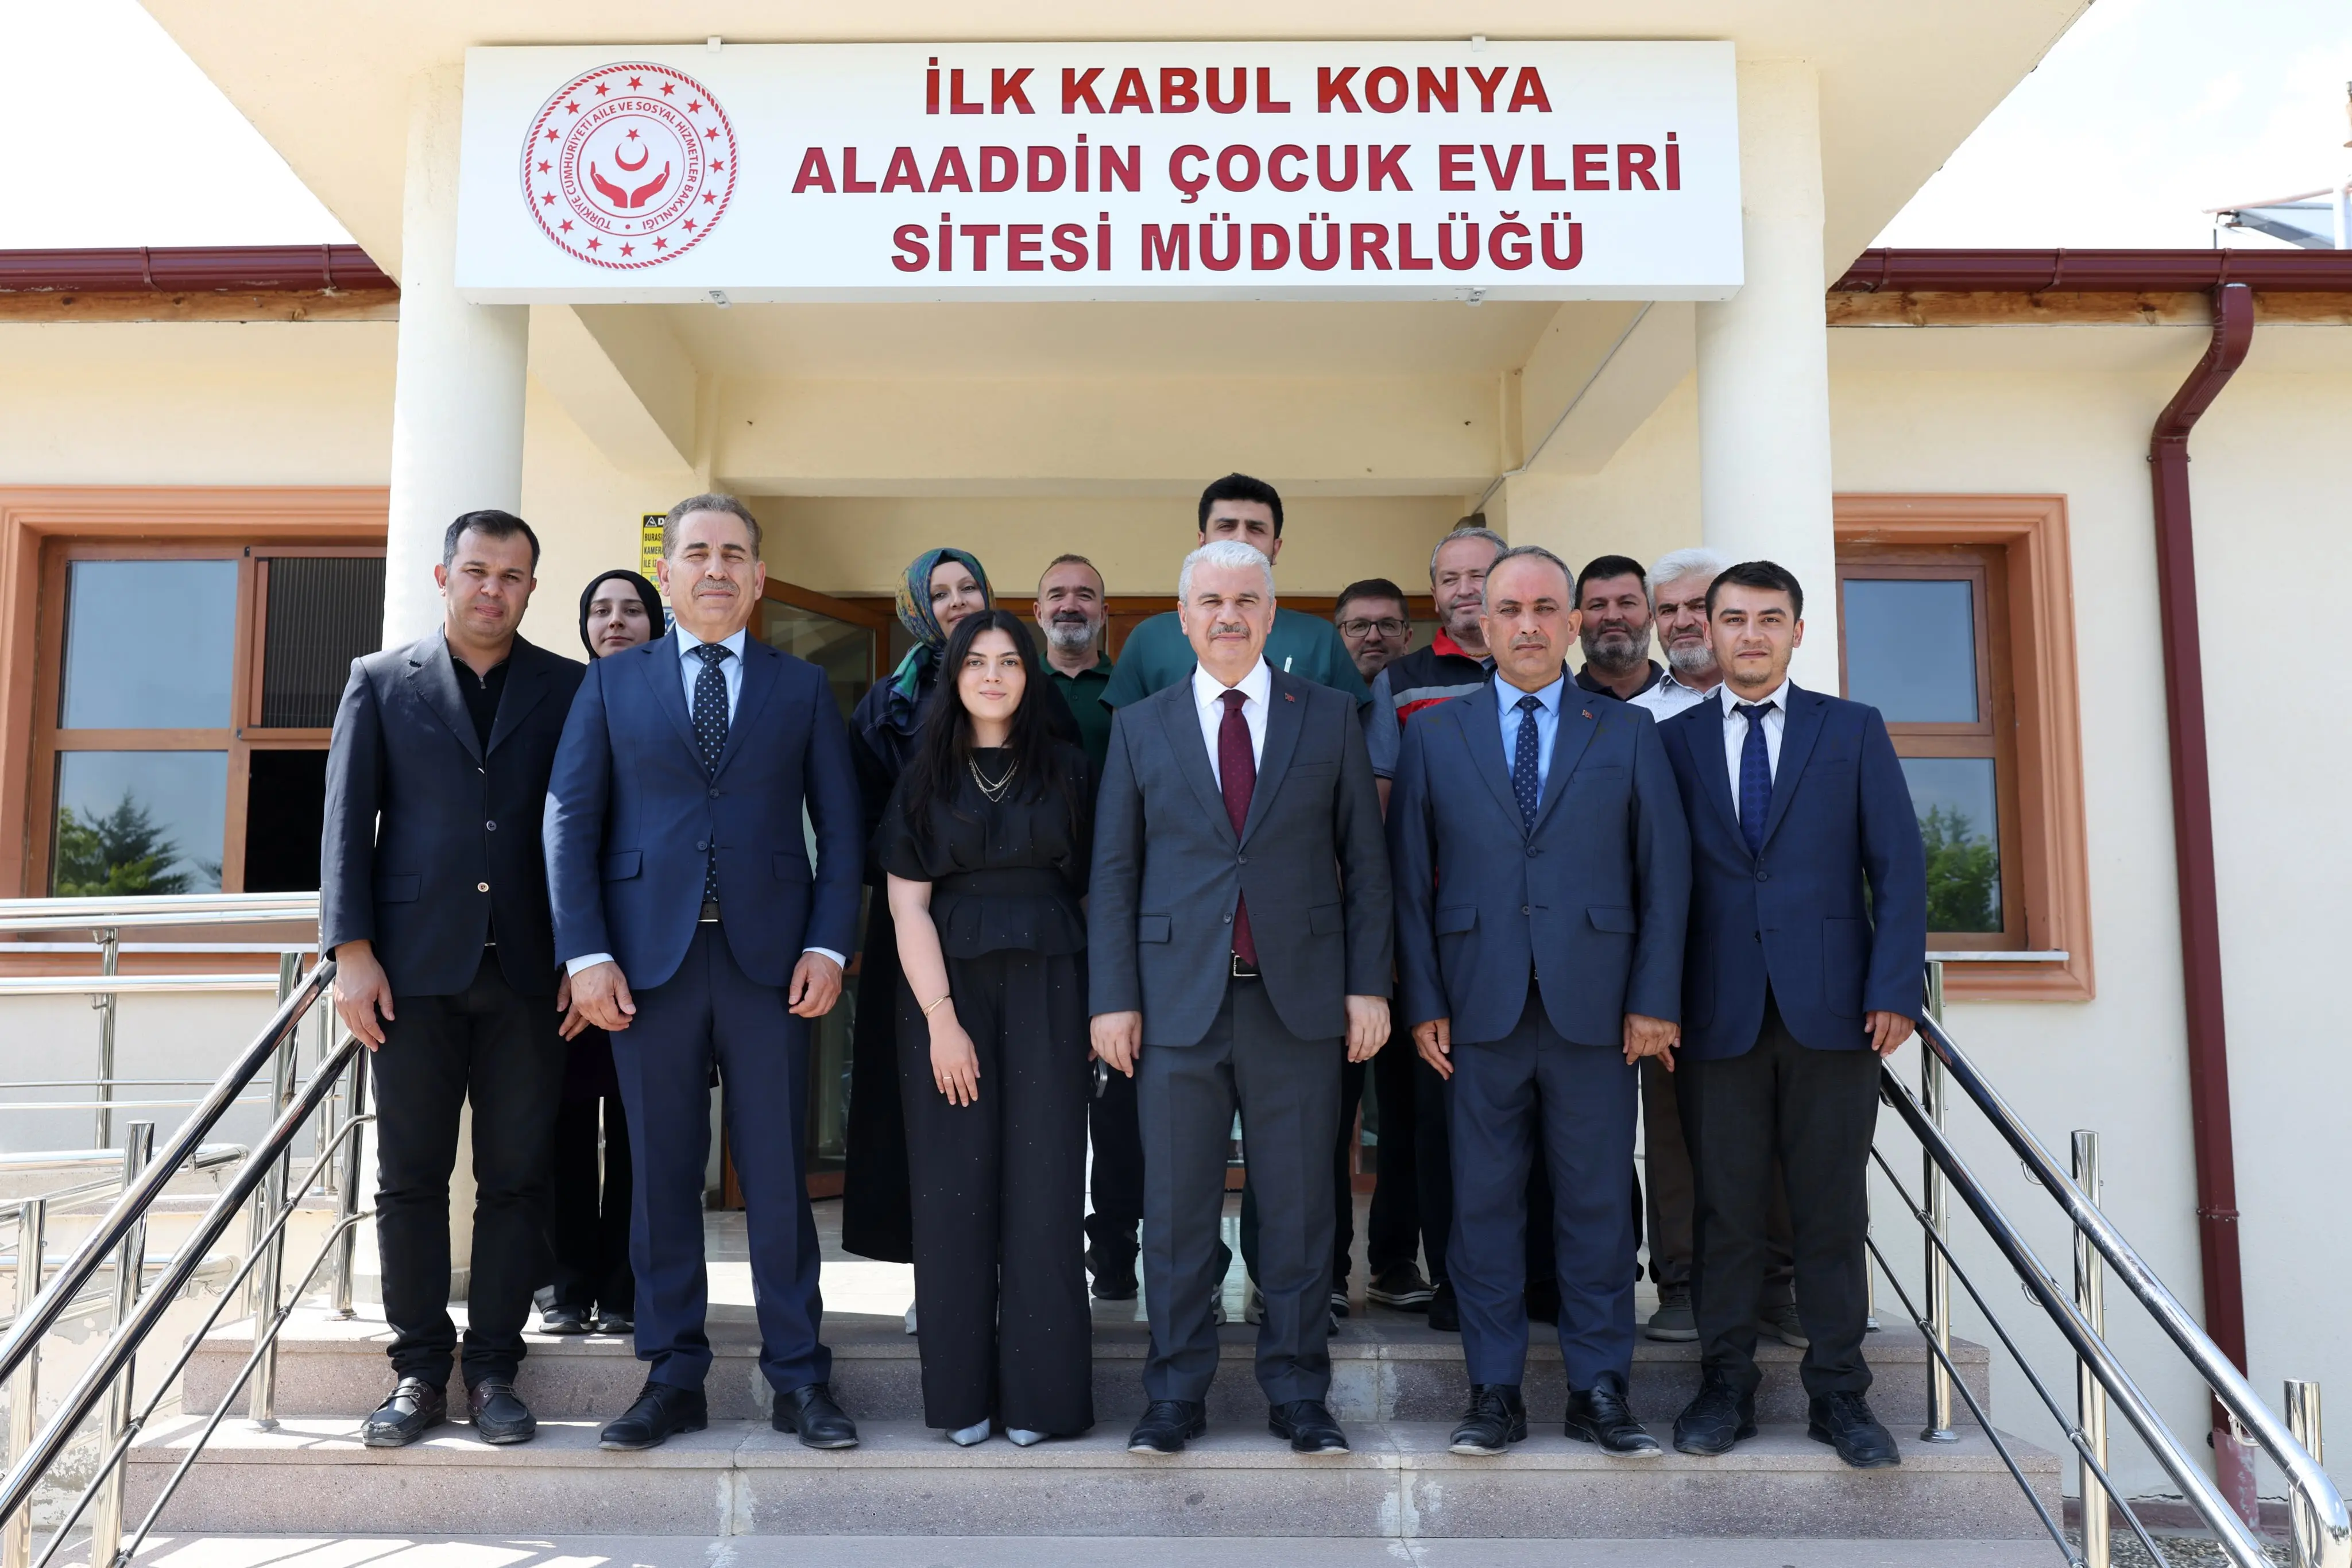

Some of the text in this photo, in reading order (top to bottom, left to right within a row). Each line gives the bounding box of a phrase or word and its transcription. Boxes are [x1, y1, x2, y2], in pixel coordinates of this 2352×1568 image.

[926, 56, 1552, 115] İLK KABUL KONYA
[563, 101, 698, 230] TÜRKİYE CUMHURİYETİ AİLE VE SOSYAL HİZMETLER BAKANLIĞI
[791, 131, 1680, 203] ALAADDİN ÇOCUK EVLERİ
[891, 211, 1583, 272] SİTESİ MÜDÜRLÜĞÜ
